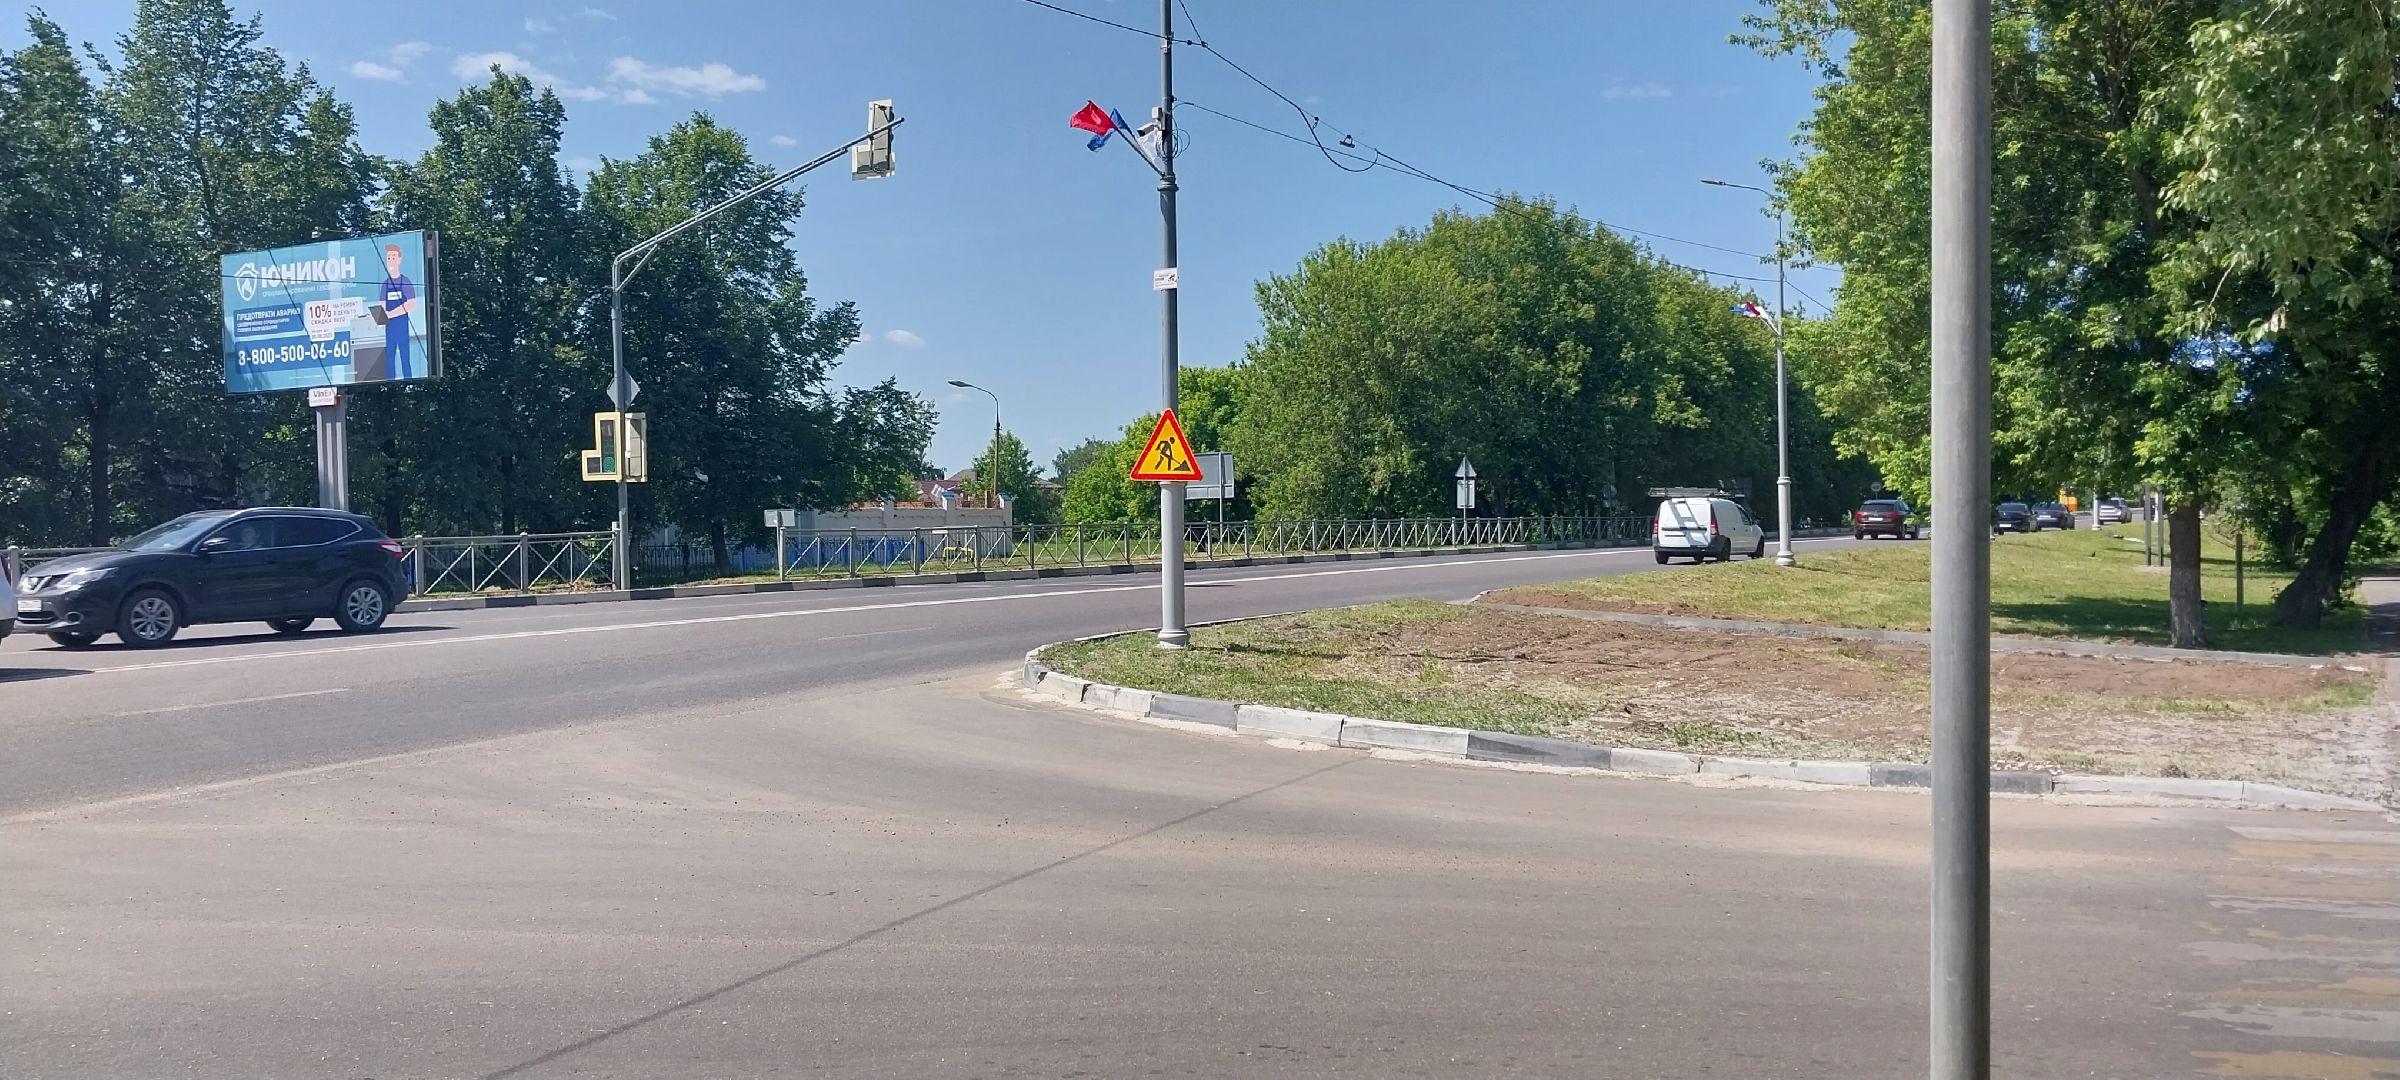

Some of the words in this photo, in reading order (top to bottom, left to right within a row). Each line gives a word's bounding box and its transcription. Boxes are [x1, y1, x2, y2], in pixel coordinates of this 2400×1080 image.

[261, 256, 356, 288] ЮНИКОН
[236, 310, 275, 321] ПРЕДОТВРАТИ
[309, 304, 332, 318] 10%
[238, 340, 350, 366] 8-800-500-06-60
